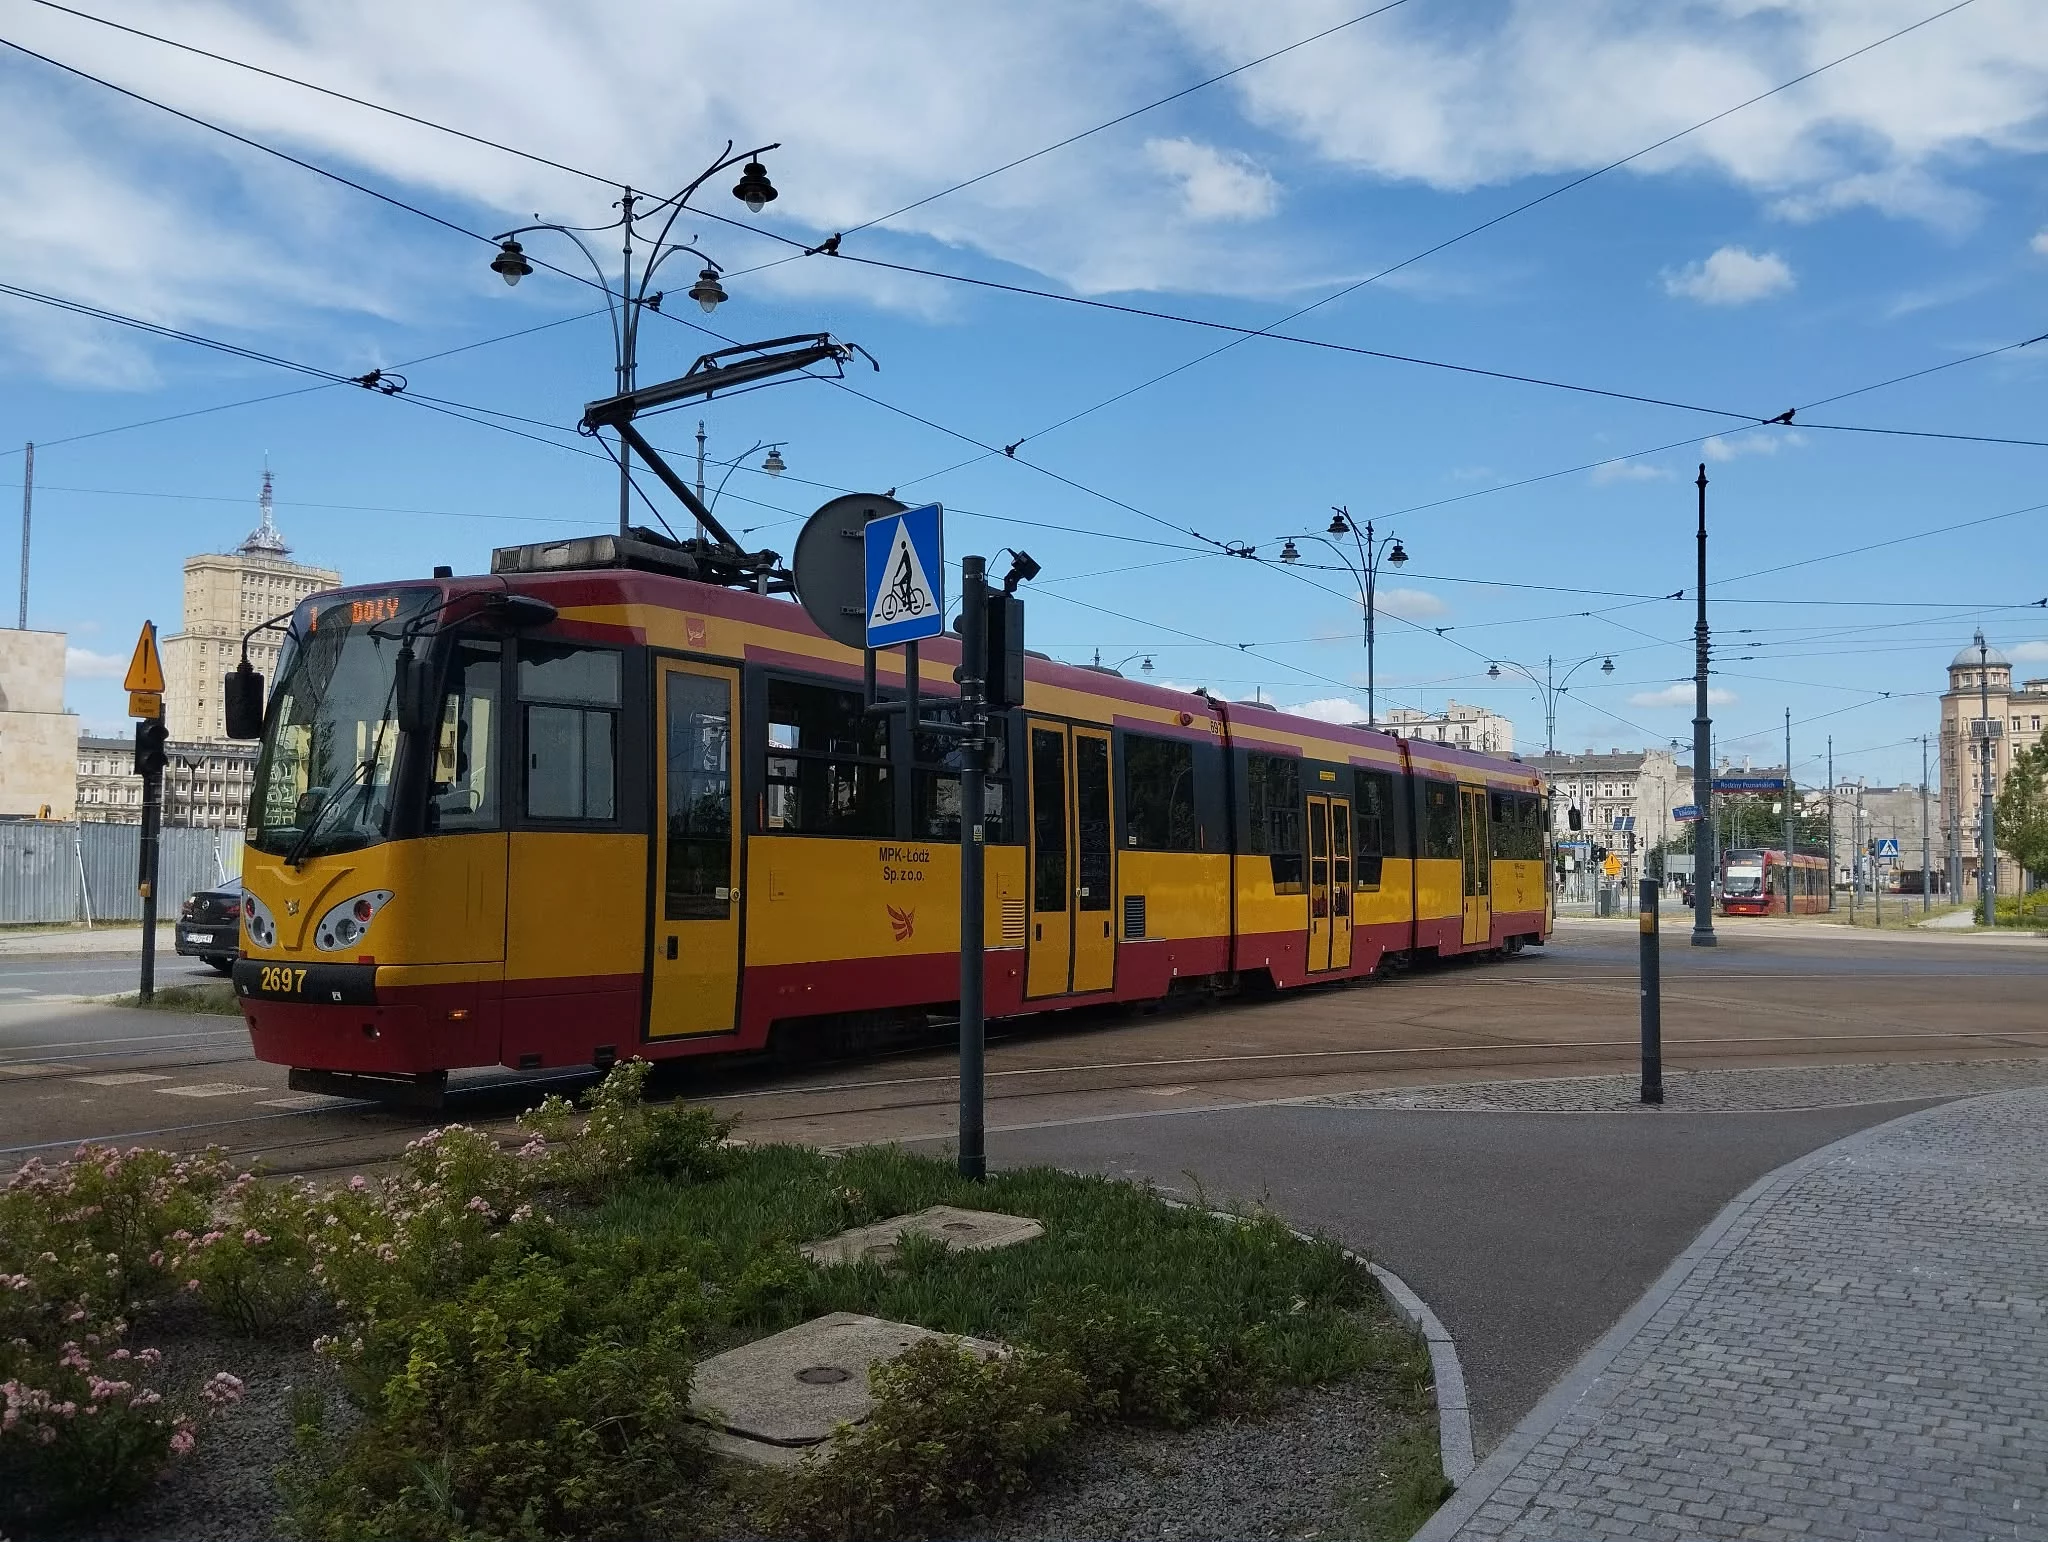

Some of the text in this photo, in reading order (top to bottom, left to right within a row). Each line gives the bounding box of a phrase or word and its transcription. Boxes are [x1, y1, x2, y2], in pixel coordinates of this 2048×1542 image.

[310, 597, 400, 631] 1 DOŁY
[879, 847, 930, 862] MPK-Łódź
[261, 966, 308, 993] 2697
